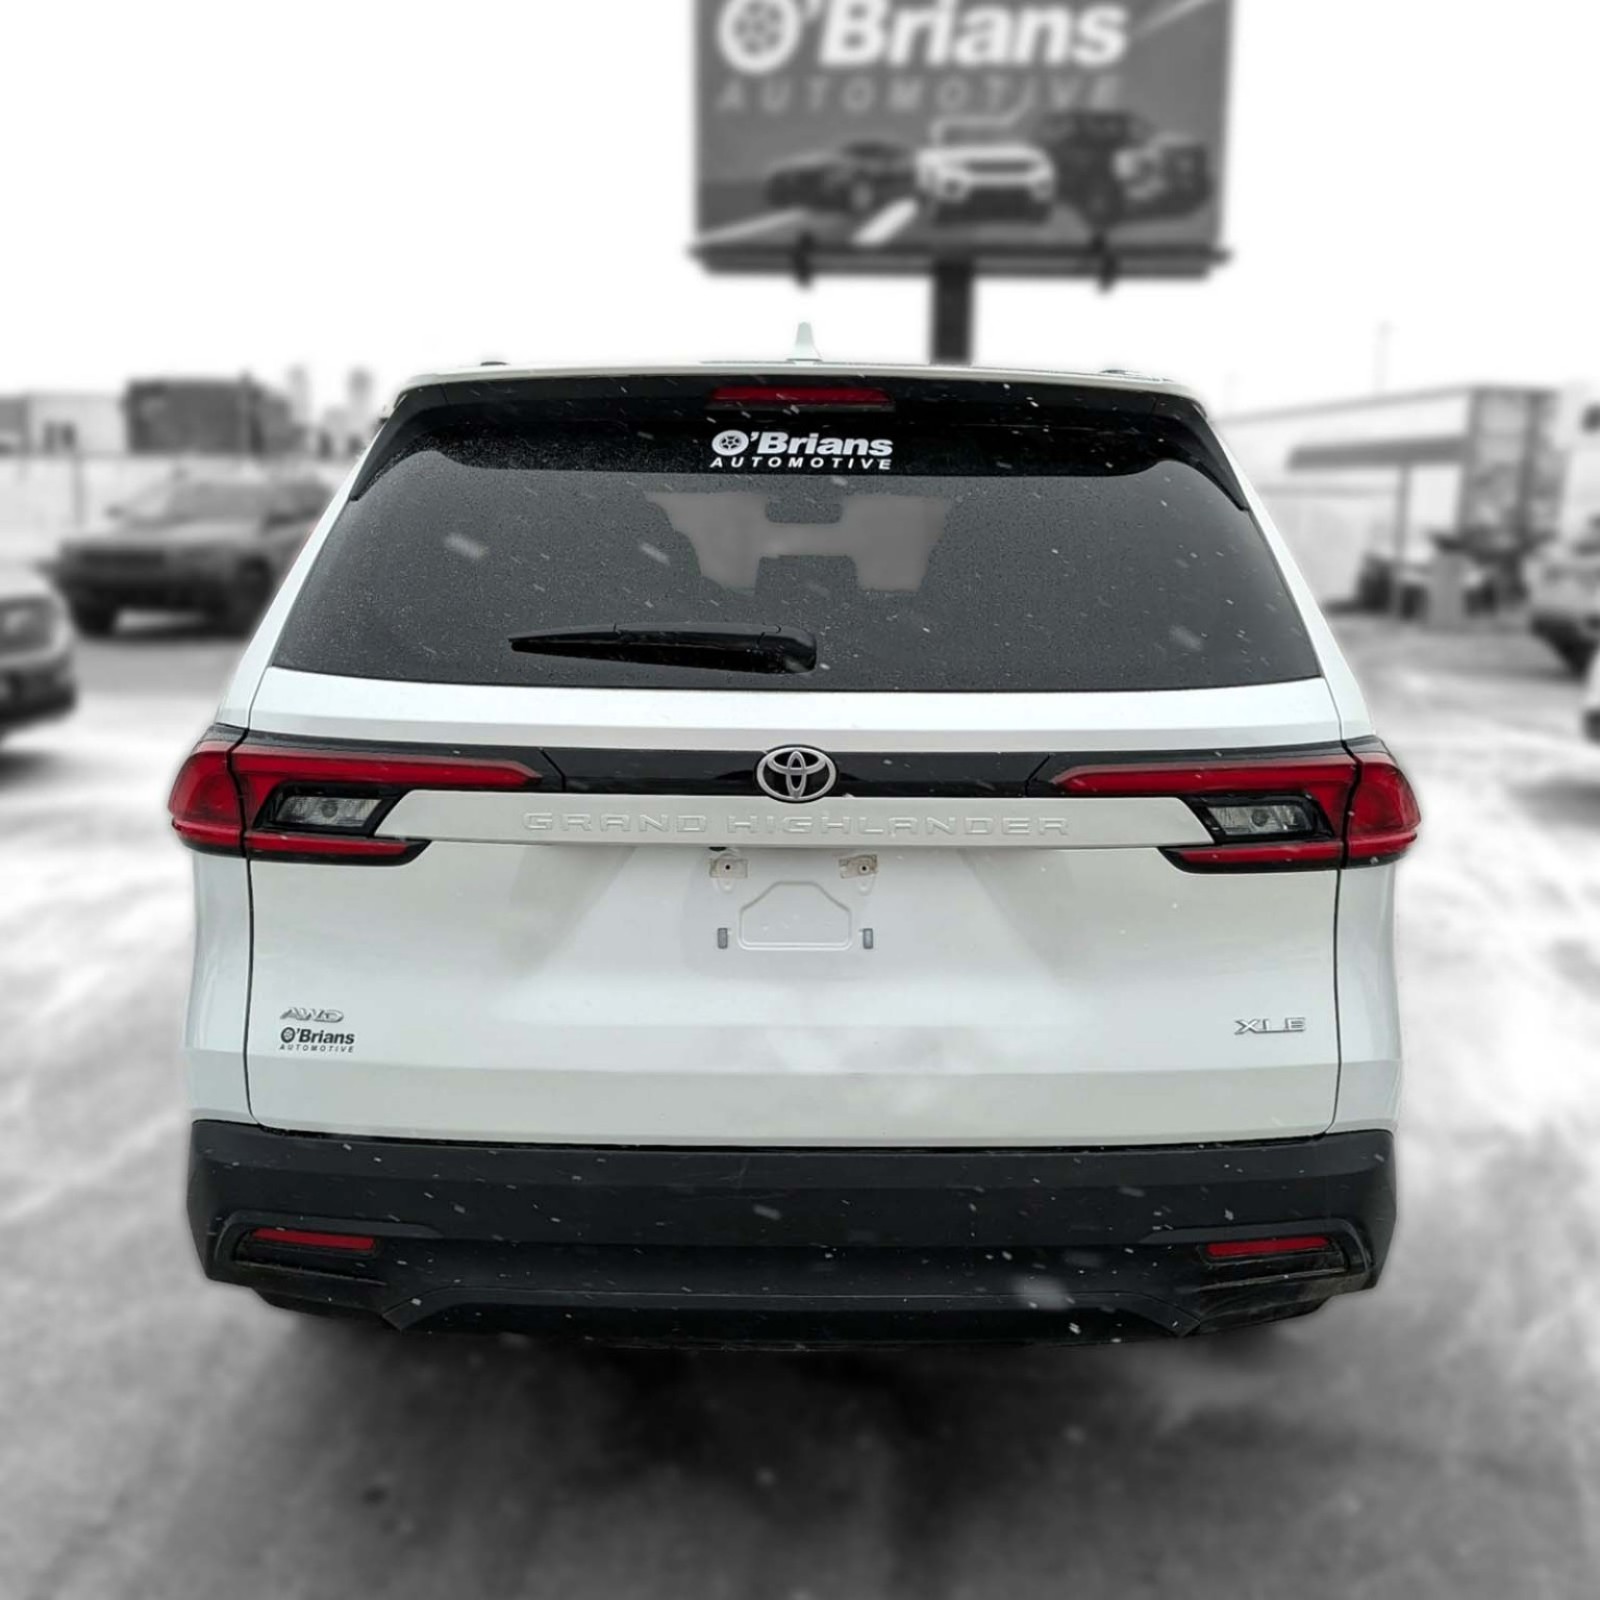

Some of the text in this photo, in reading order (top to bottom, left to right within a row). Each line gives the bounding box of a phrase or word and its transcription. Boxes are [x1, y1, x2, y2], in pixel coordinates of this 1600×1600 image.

[715, 0, 1130, 74] O'Brians
[716, 76, 1125, 113] AUTOMOTIVE
[711, 429, 894, 457] O'Brians
[709, 456, 892, 471] AUTOMOTIVE
[522, 811, 1070, 837] GRAND HIGHLANDER
[279, 1006, 345, 1024] AWD
[280, 1026, 356, 1045] O'Brians
[1233, 1016, 1307, 1036] XLE
[279, 1043, 355, 1054] AUTOMOTIVE
